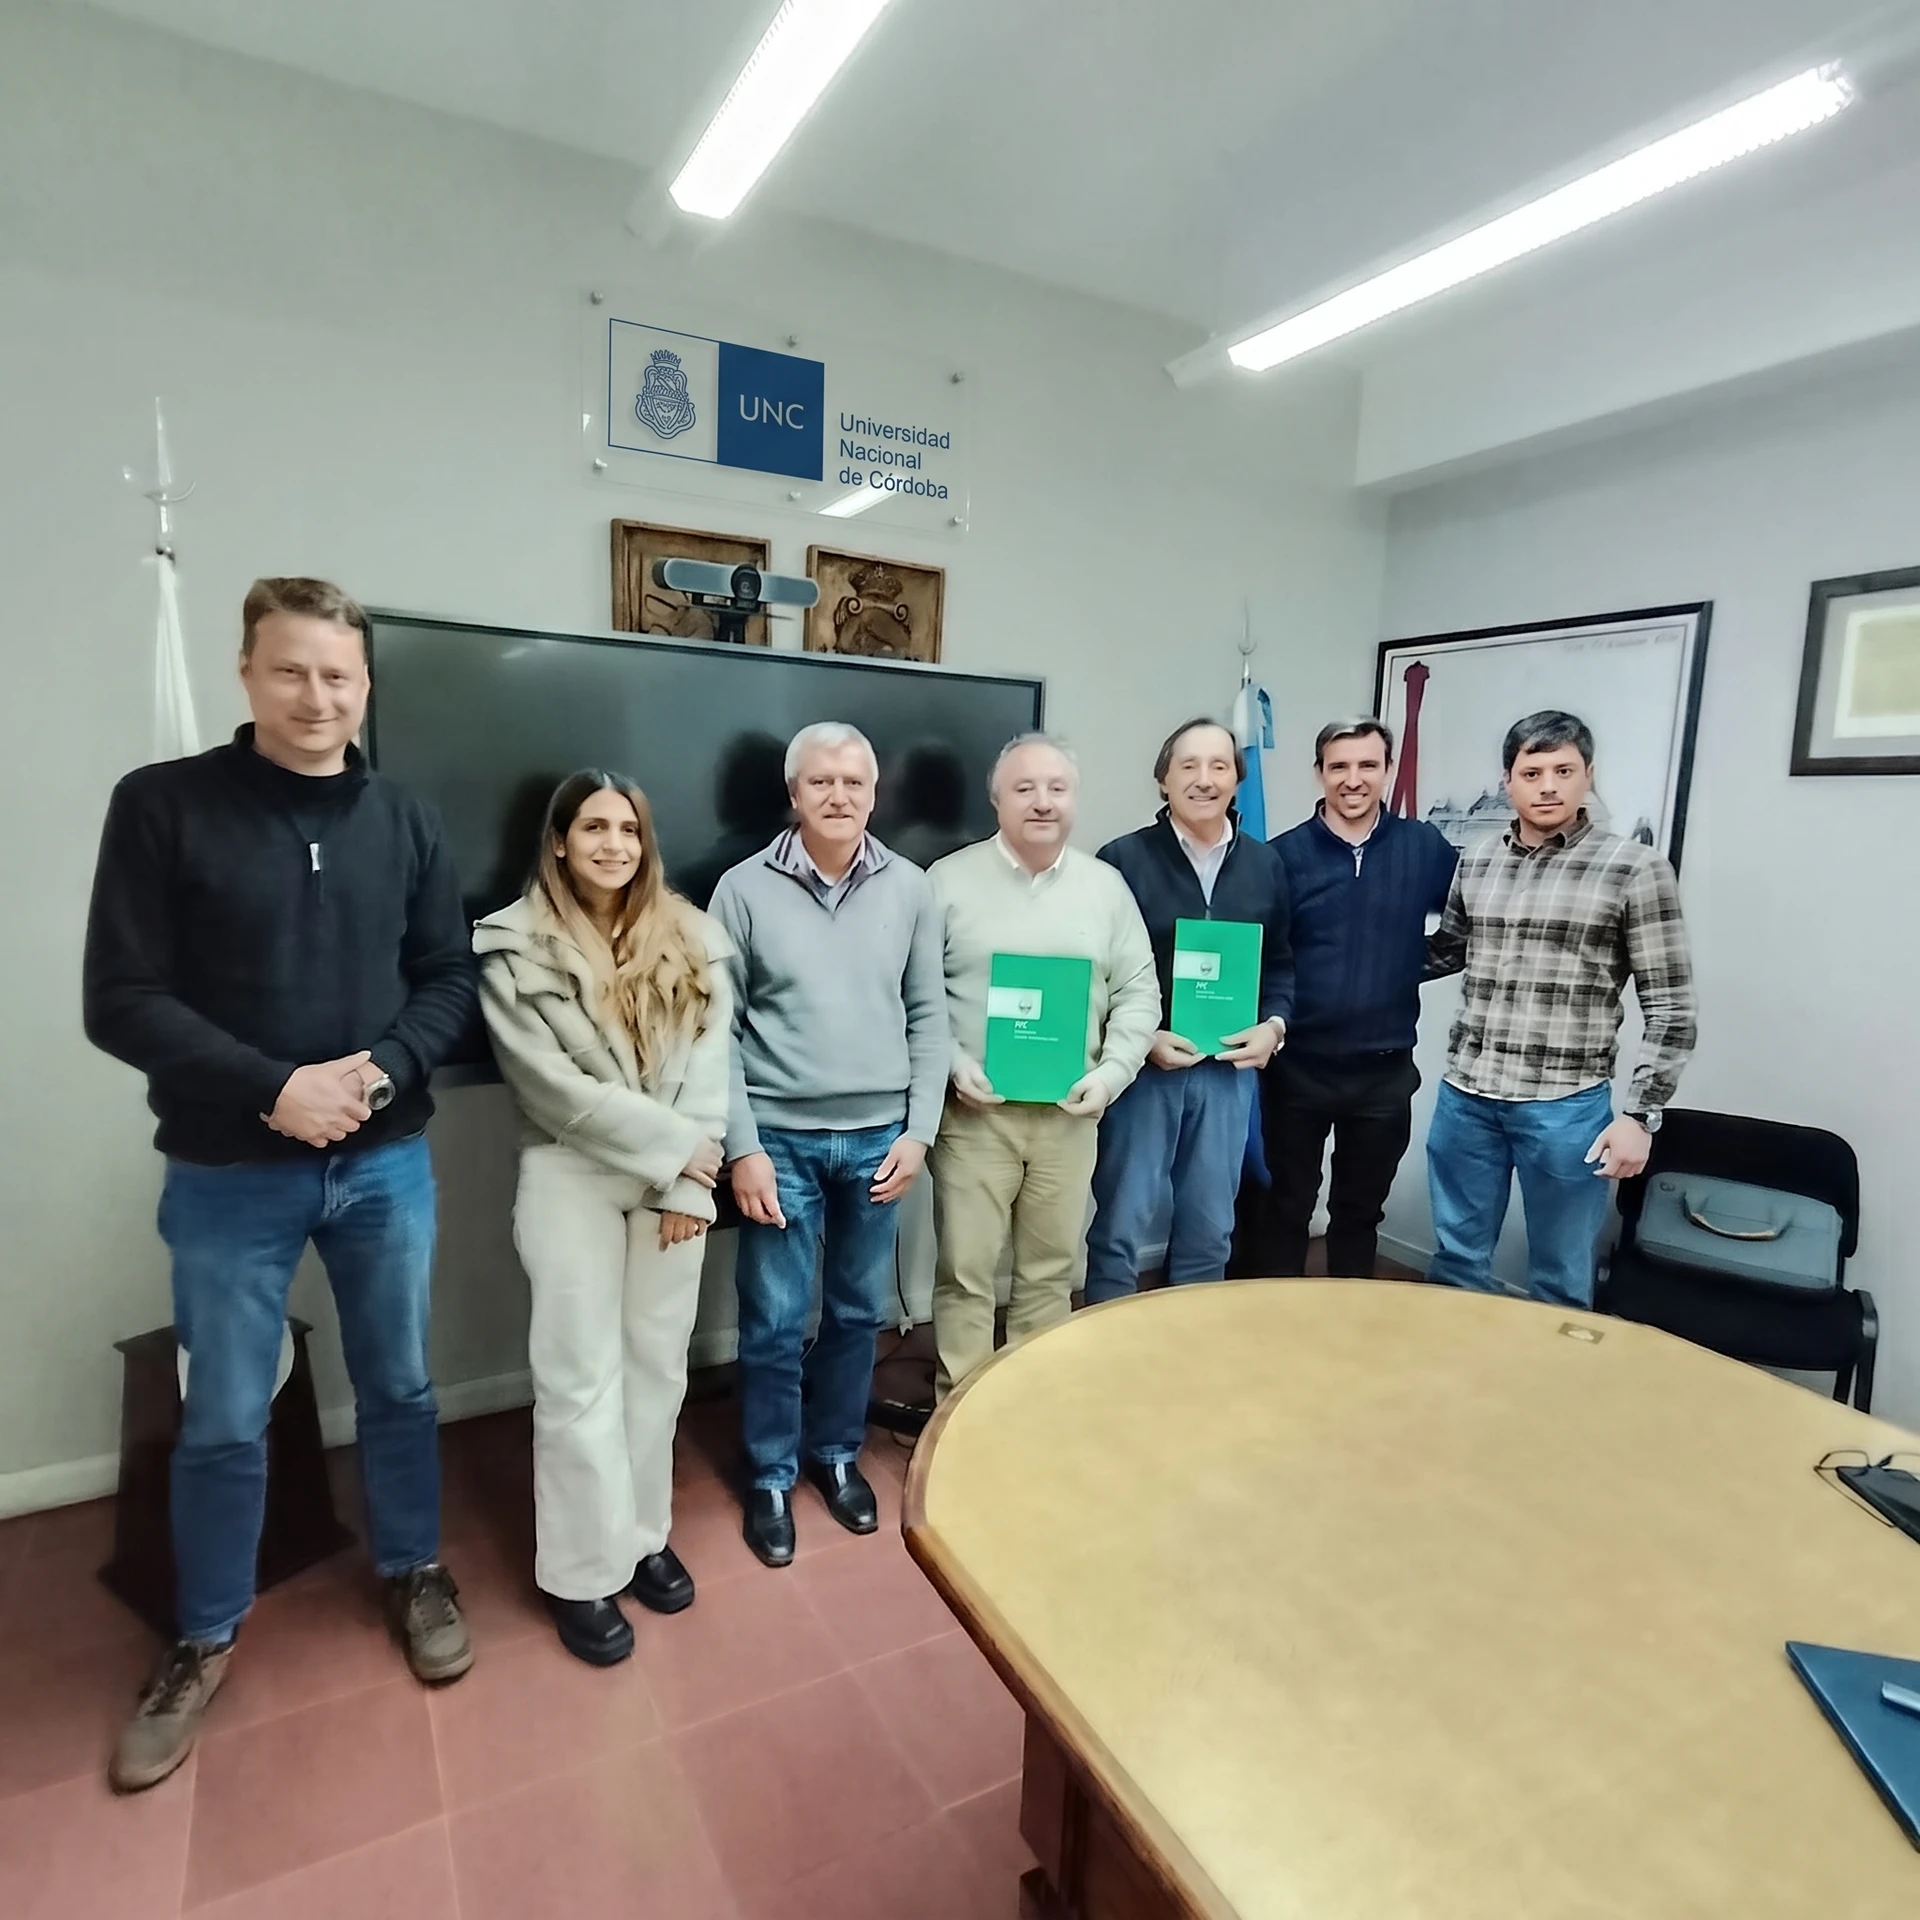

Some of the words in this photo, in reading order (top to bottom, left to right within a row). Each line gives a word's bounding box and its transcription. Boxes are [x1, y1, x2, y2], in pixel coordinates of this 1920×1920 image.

[740, 394, 804, 430] UNC
[840, 412, 950, 450] Universidad
[840, 438, 921, 470] Nacional
[839, 466, 863, 486] de
[870, 470, 948, 500] Córdoba
